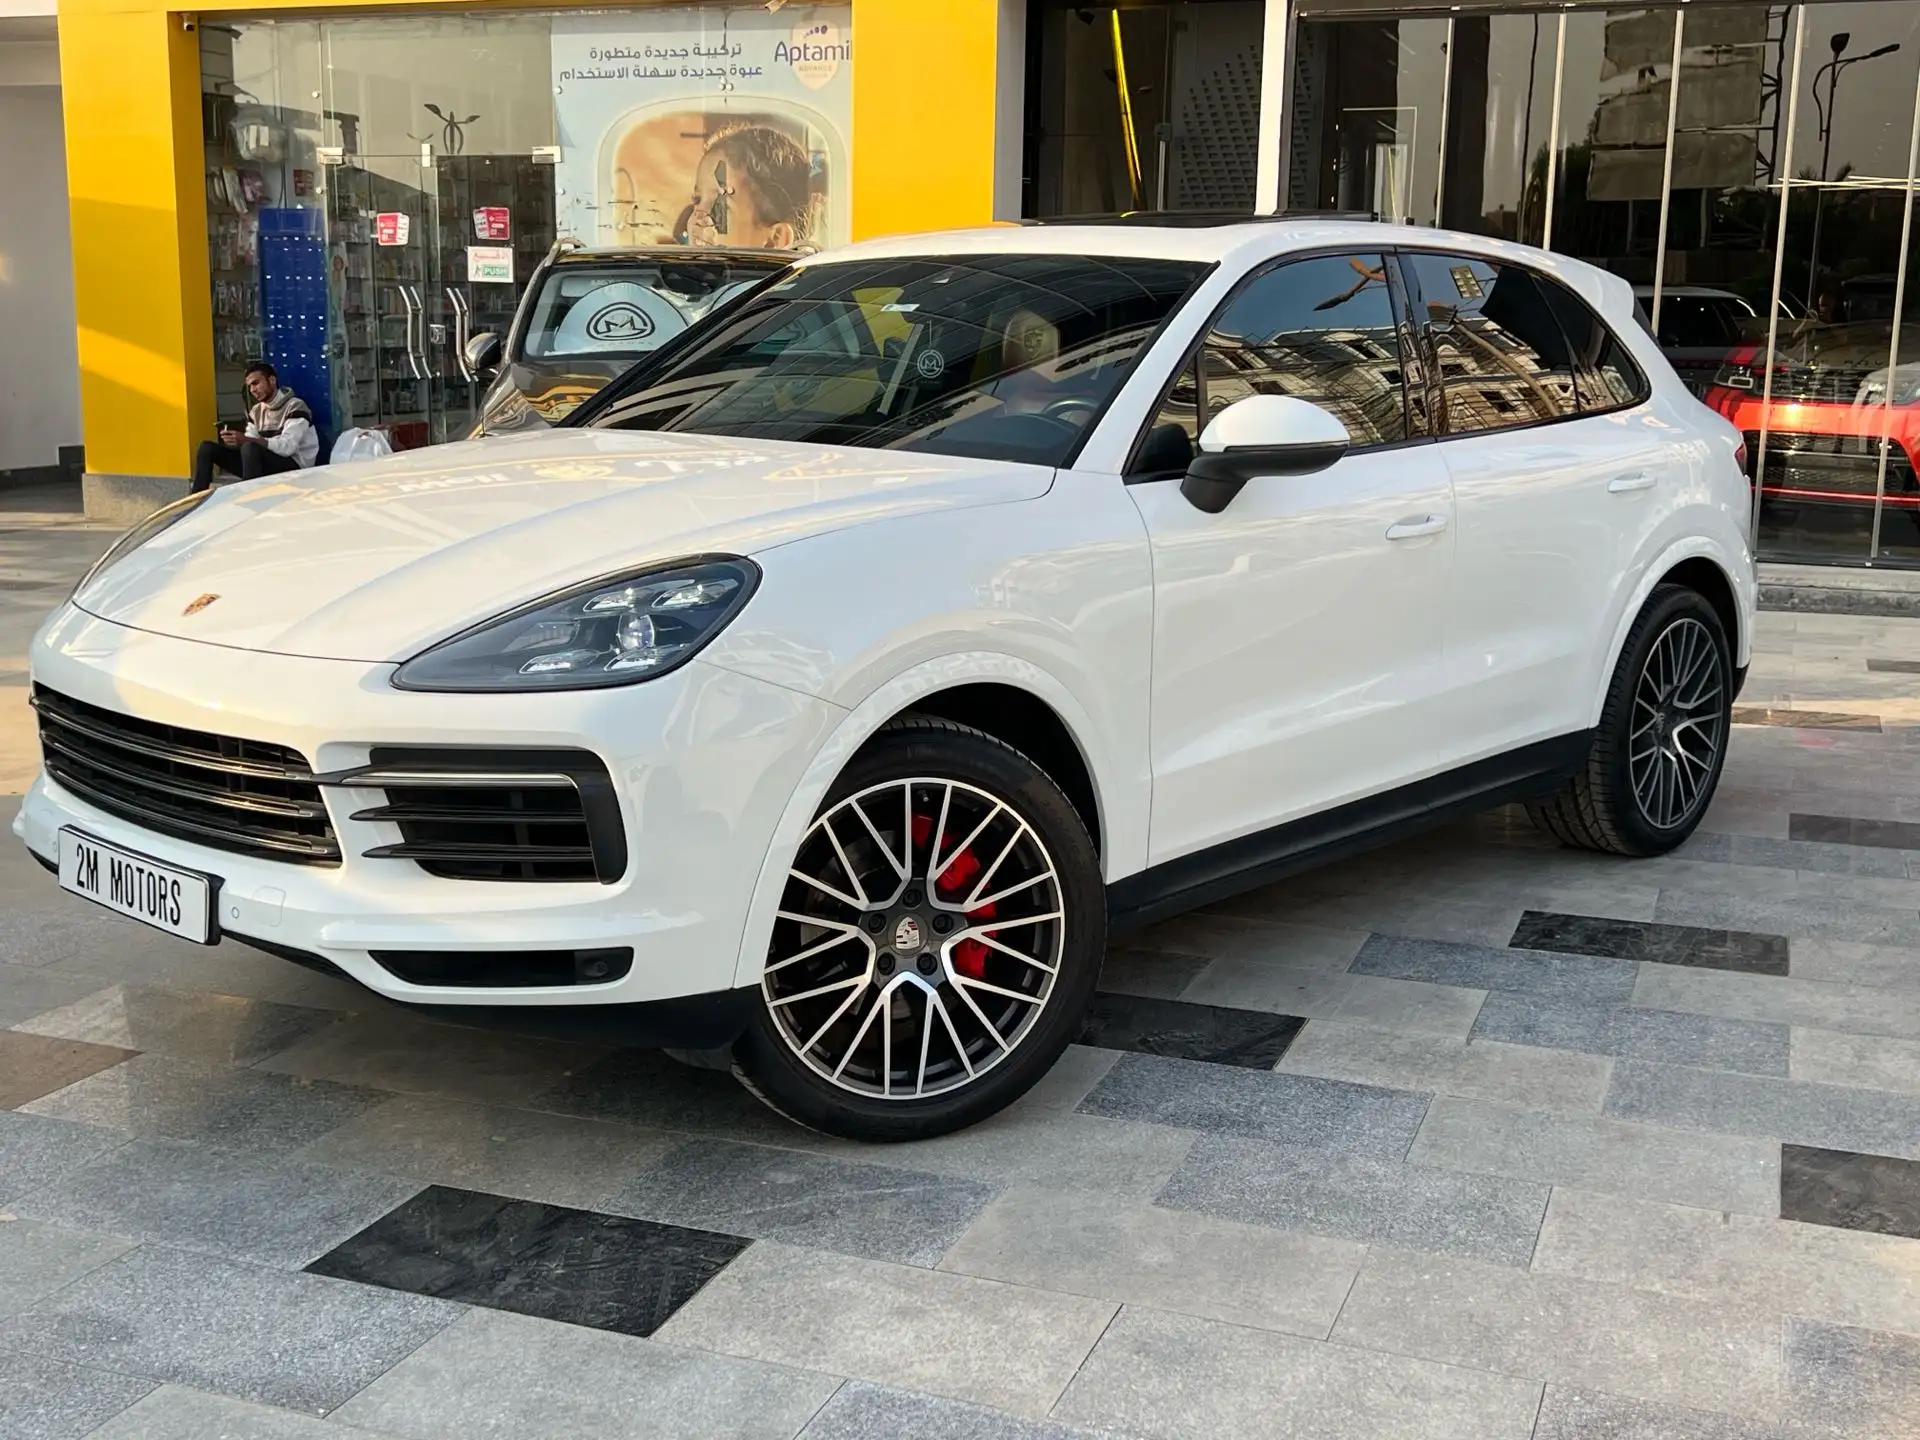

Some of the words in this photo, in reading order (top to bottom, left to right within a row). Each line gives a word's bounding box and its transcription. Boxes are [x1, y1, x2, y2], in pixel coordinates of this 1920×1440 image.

[589, 47, 641, 62] متطورة
[645, 45, 689, 60] جديدة
[693, 42, 742, 58] تركيبة
[559, 66, 629, 82] الاستخدام
[632, 64, 677, 79] سهلة
[680, 64, 727, 79] جديدة
[729, 63, 763, 78] عبوة
[484, 266, 507, 276] PUSH
[76, 843, 99, 894] 2M
[110, 857, 181, 926] MOTORS
